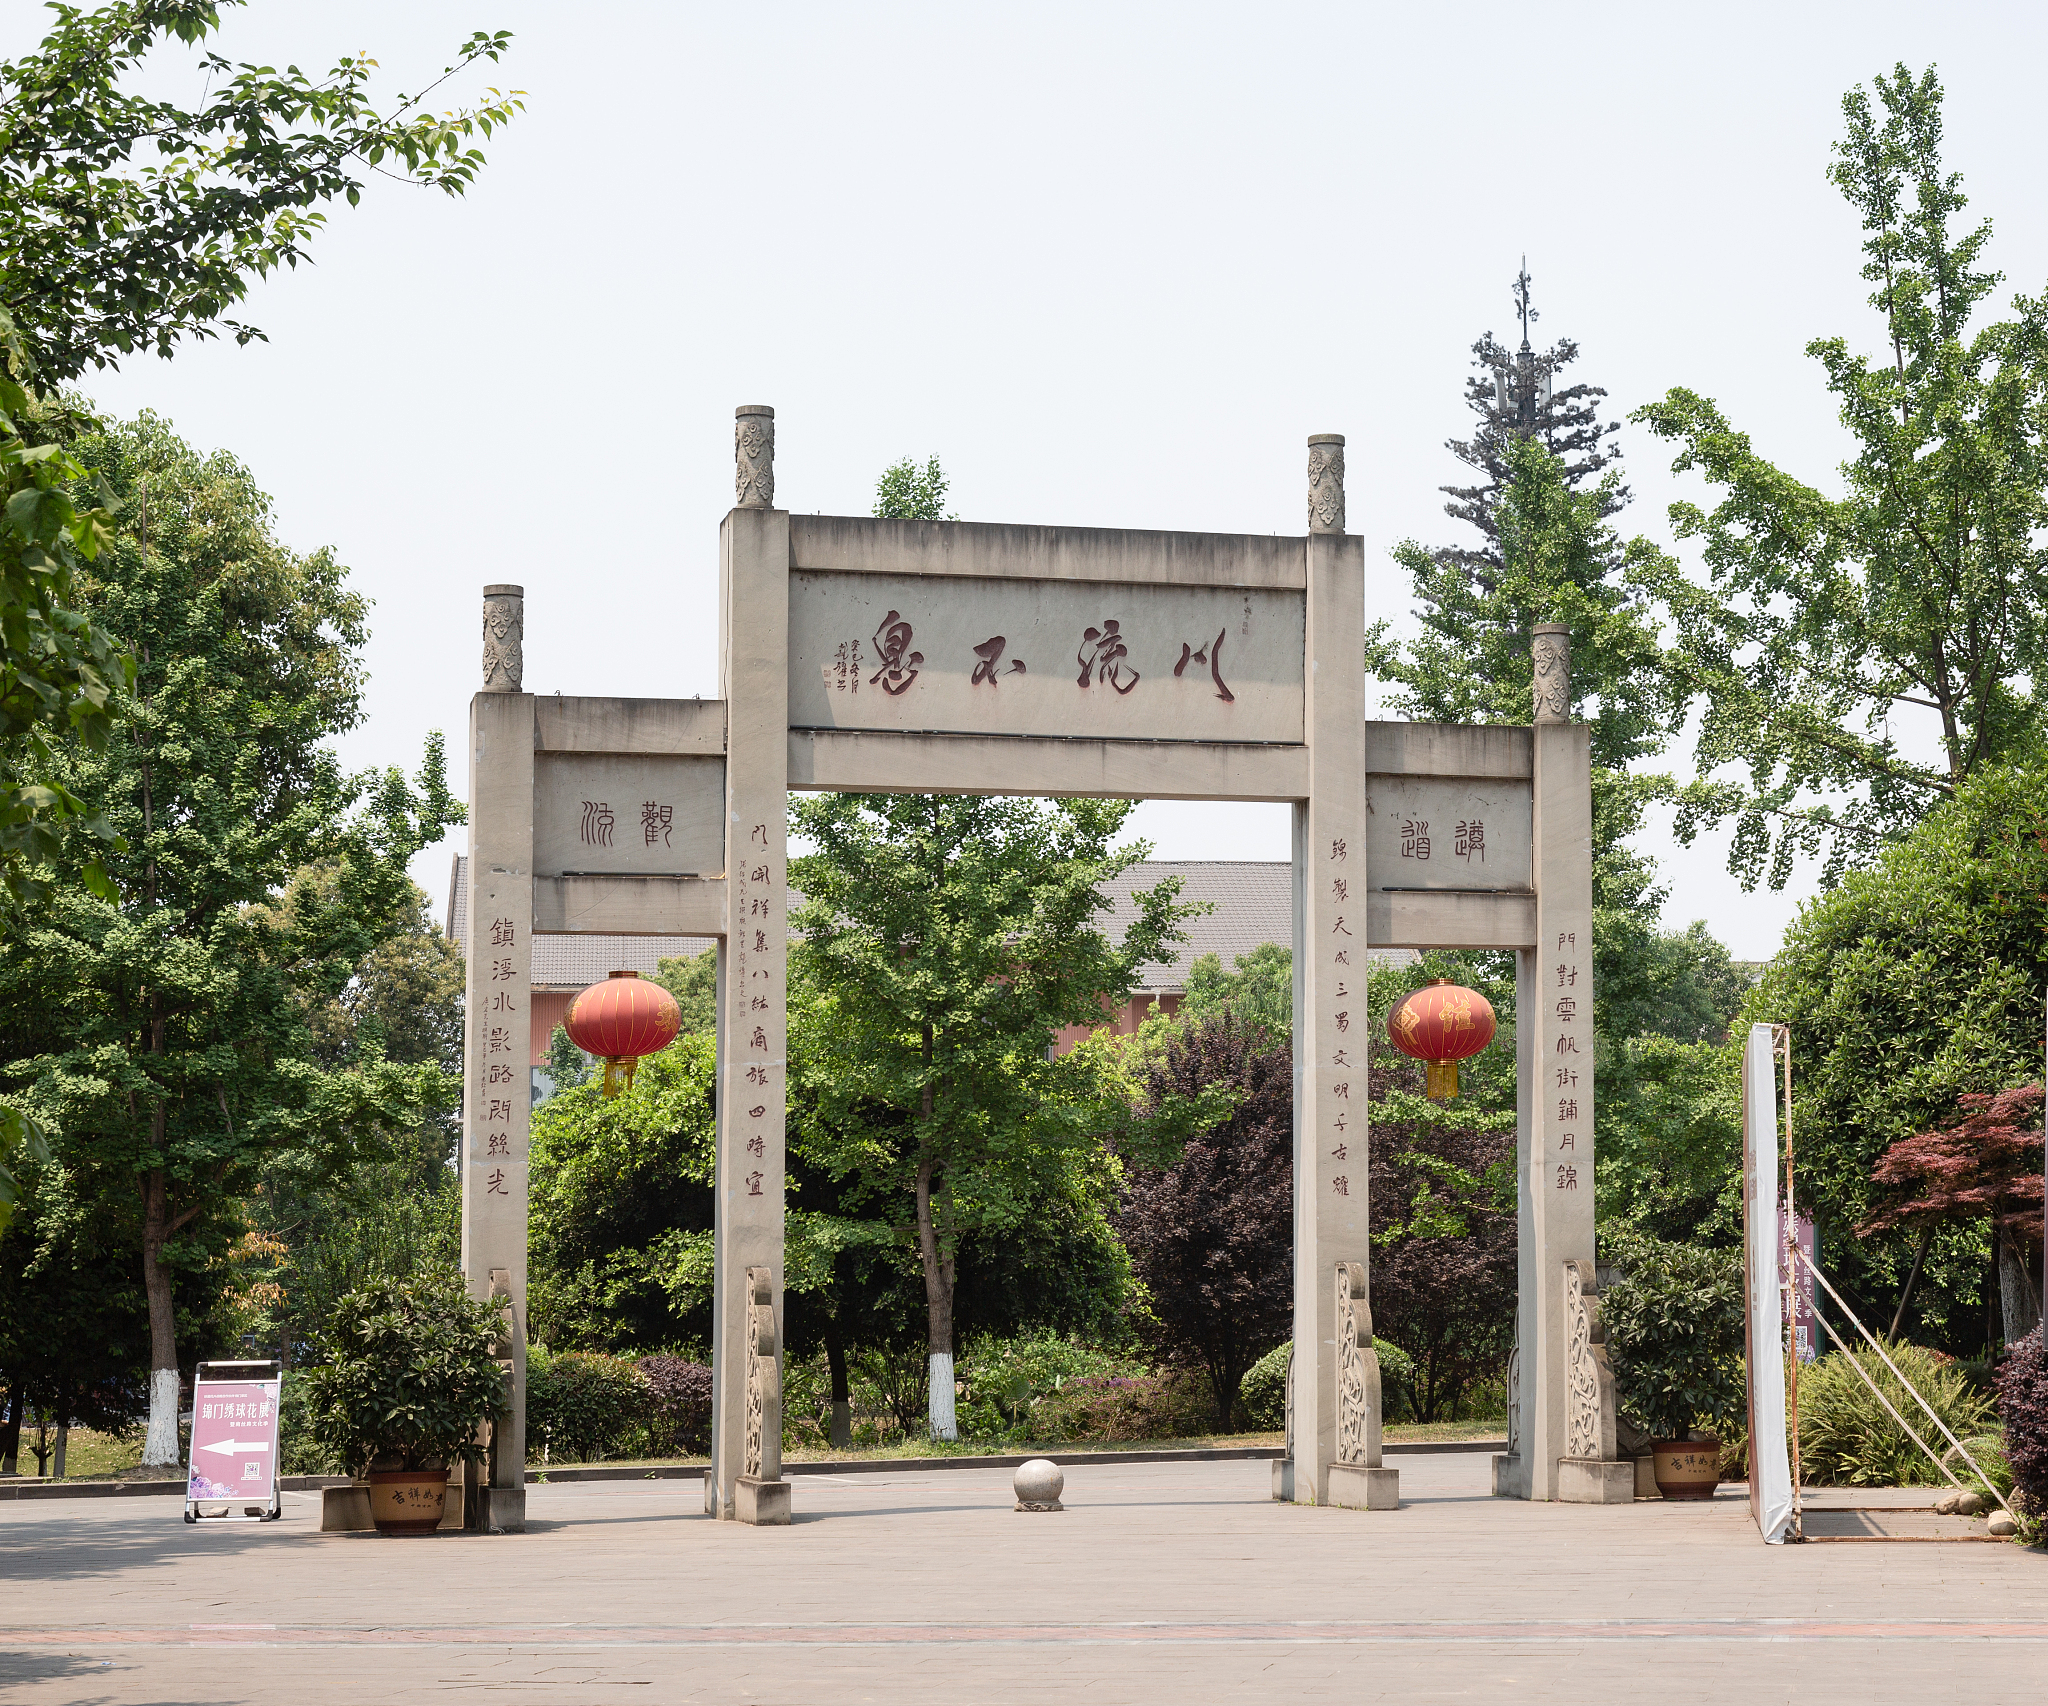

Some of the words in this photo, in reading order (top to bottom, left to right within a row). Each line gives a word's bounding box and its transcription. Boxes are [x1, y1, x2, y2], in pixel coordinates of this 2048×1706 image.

[202, 1402, 269, 1419] 锦门绣球花展
